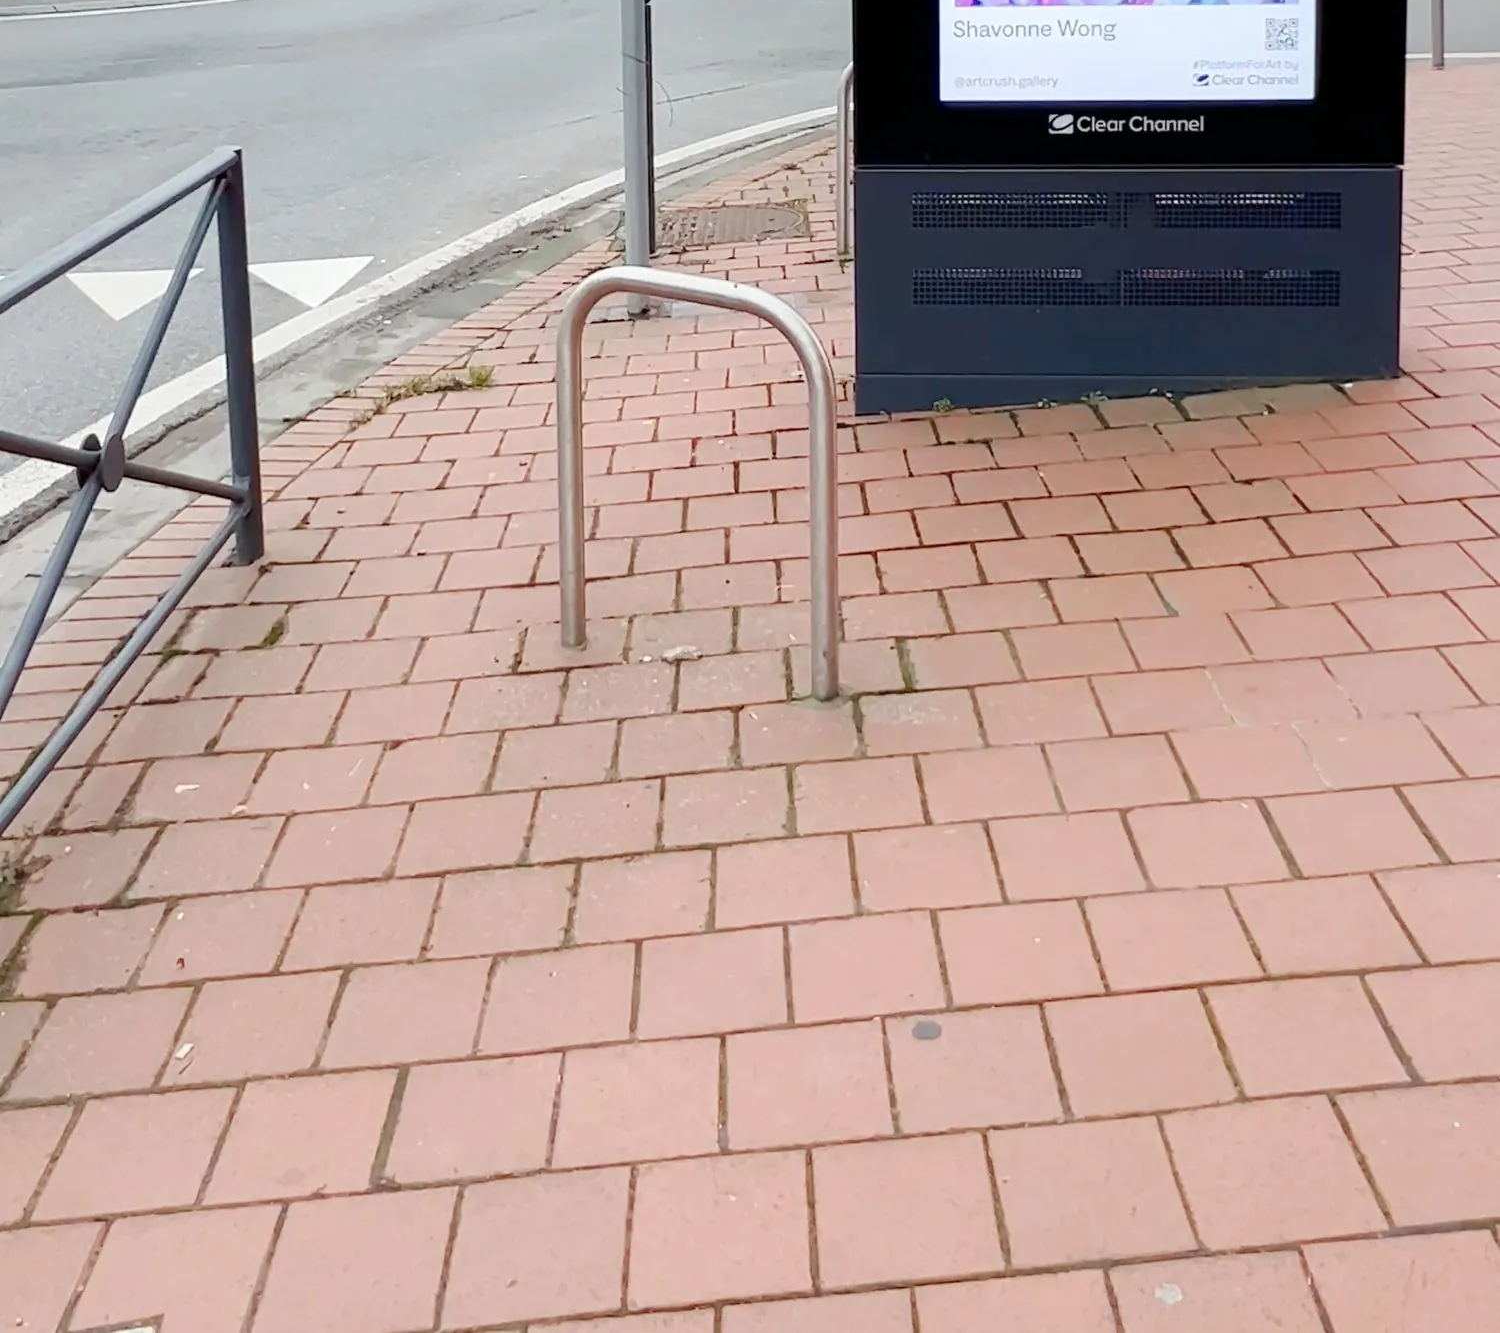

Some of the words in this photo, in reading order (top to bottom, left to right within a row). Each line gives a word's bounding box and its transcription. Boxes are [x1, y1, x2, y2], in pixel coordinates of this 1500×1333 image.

[953, 20, 1052, 38] Shavonne
[1057, 19, 1118, 42] Wong
[1284, 60, 1299, 71] by
[954, 76, 1060, 89] @artcrush.gallery
[1211, 74, 1245, 86] Clear
[1247, 74, 1299, 86] Channel
[1076, 116, 1126, 132] Clear
[1128, 115, 1204, 132] Channel
